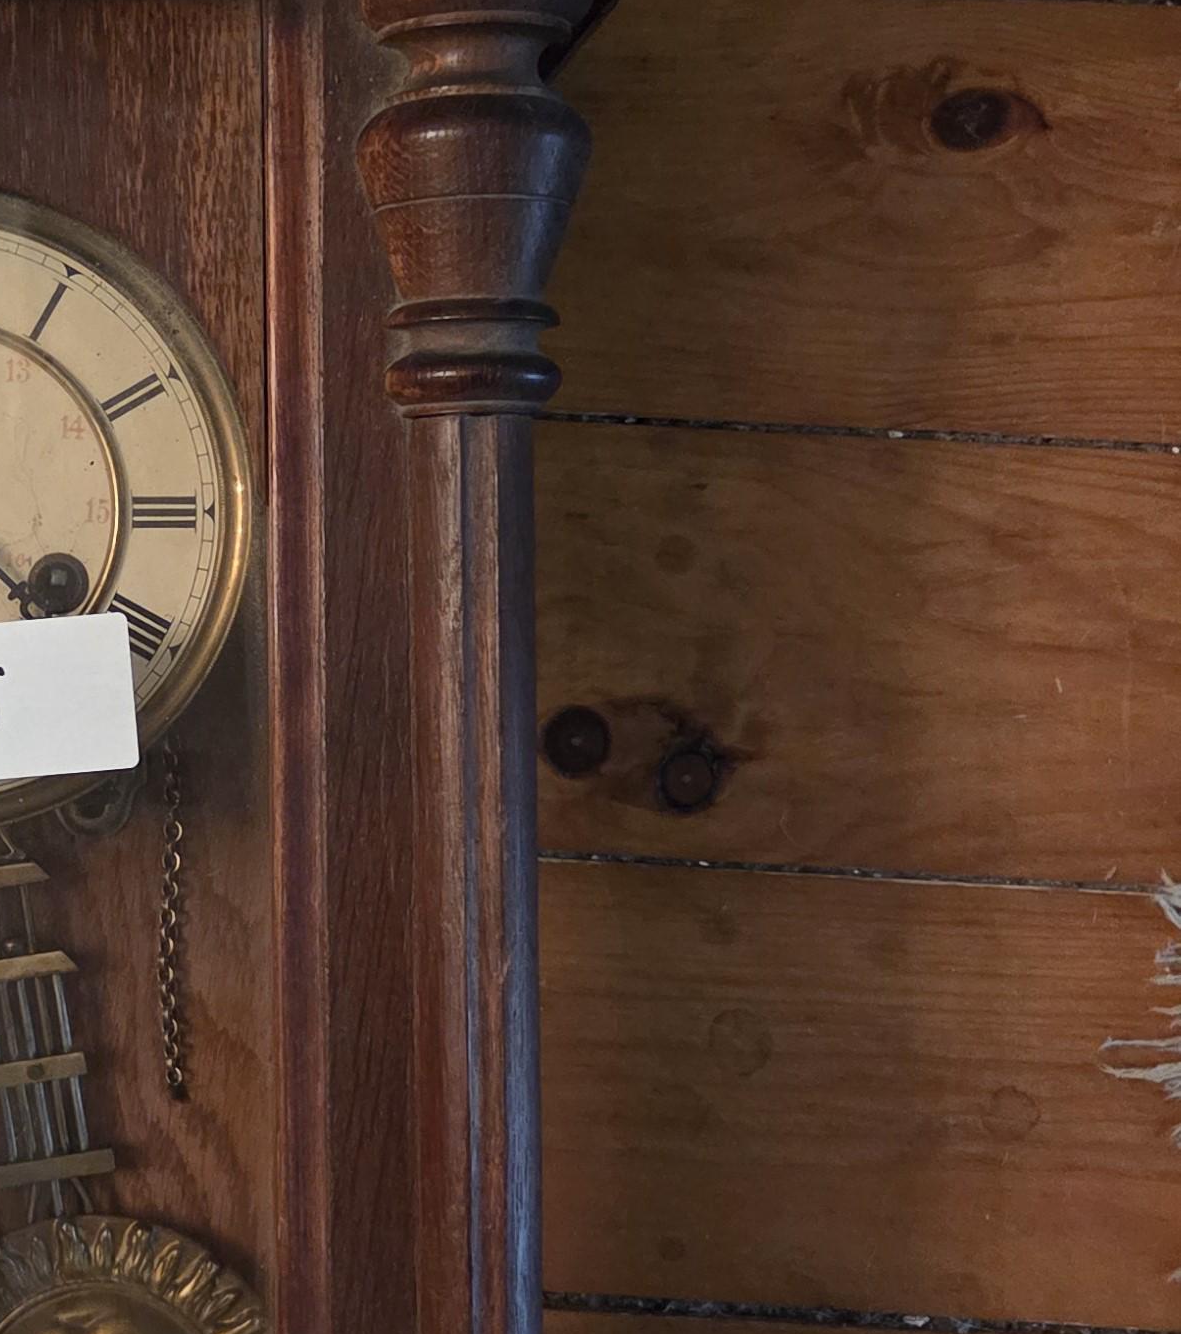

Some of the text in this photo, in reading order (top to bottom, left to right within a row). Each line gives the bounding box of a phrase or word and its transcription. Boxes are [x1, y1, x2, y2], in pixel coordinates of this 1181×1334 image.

[22, 277, 75, 345] I
[6, 356, 31, 383] 13
[96, 365, 170, 429] II
[61, 415, 86, 441] 14
[85, 497, 110, 525] 15
[130, 488, 198, 534] III
